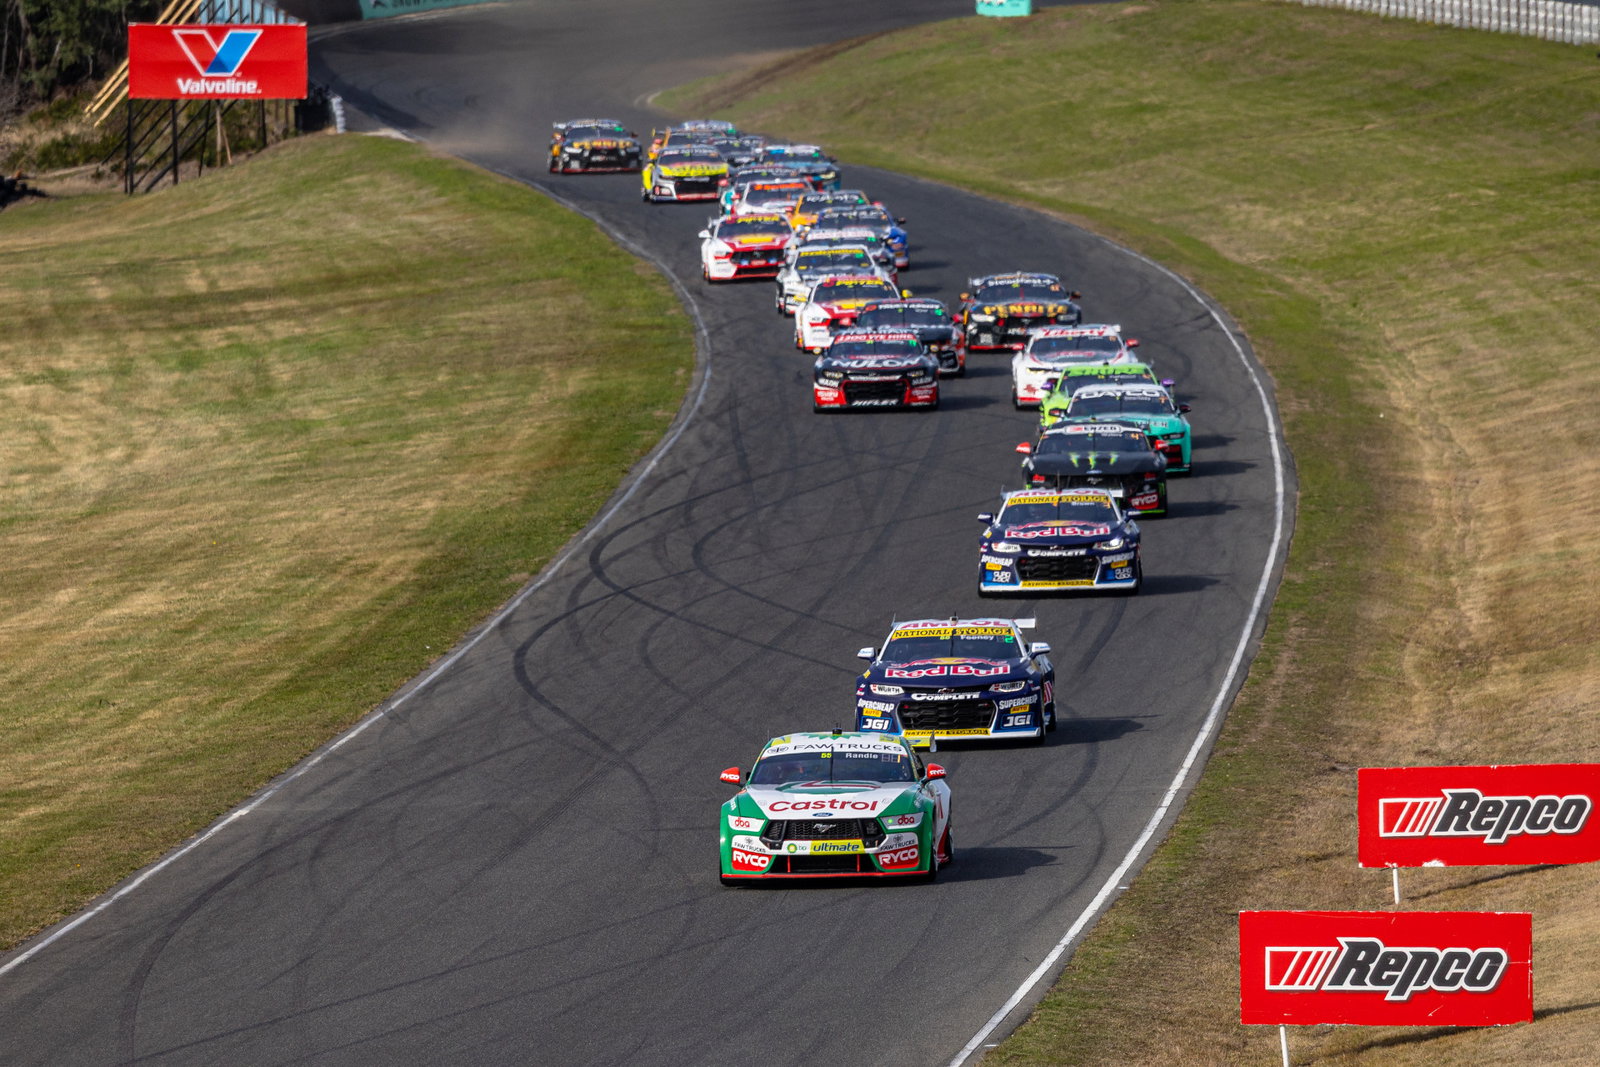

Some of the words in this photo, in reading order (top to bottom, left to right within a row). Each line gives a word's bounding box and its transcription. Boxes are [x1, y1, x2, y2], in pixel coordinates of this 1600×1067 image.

[832, 357, 922, 368] NULON
[1005, 527, 1057, 539] Red
[1059, 526, 1110, 537] Bull
[895, 629, 950, 637] NATIONAL
[956, 628, 1012, 636] STORAGE
[885, 665, 947, 678] Red
[950, 664, 1010, 677] Bull
[862, 718, 889, 730] JGI
[1003, 714, 1031, 727] JGI
[793, 743, 833, 751] FAW
[836, 743, 902, 752] TRUCKS
[769, 798, 878, 812] Castrol
[734, 817, 750, 828] dba
[897, 815, 915, 825] dba
[1429, 788, 1592, 844] Repco
[813, 842, 860, 852] ultimate
[733, 850, 770, 867] RYCO
[878, 848, 918, 865] RYCO
[1321, 937, 1508, 1001] Repco
